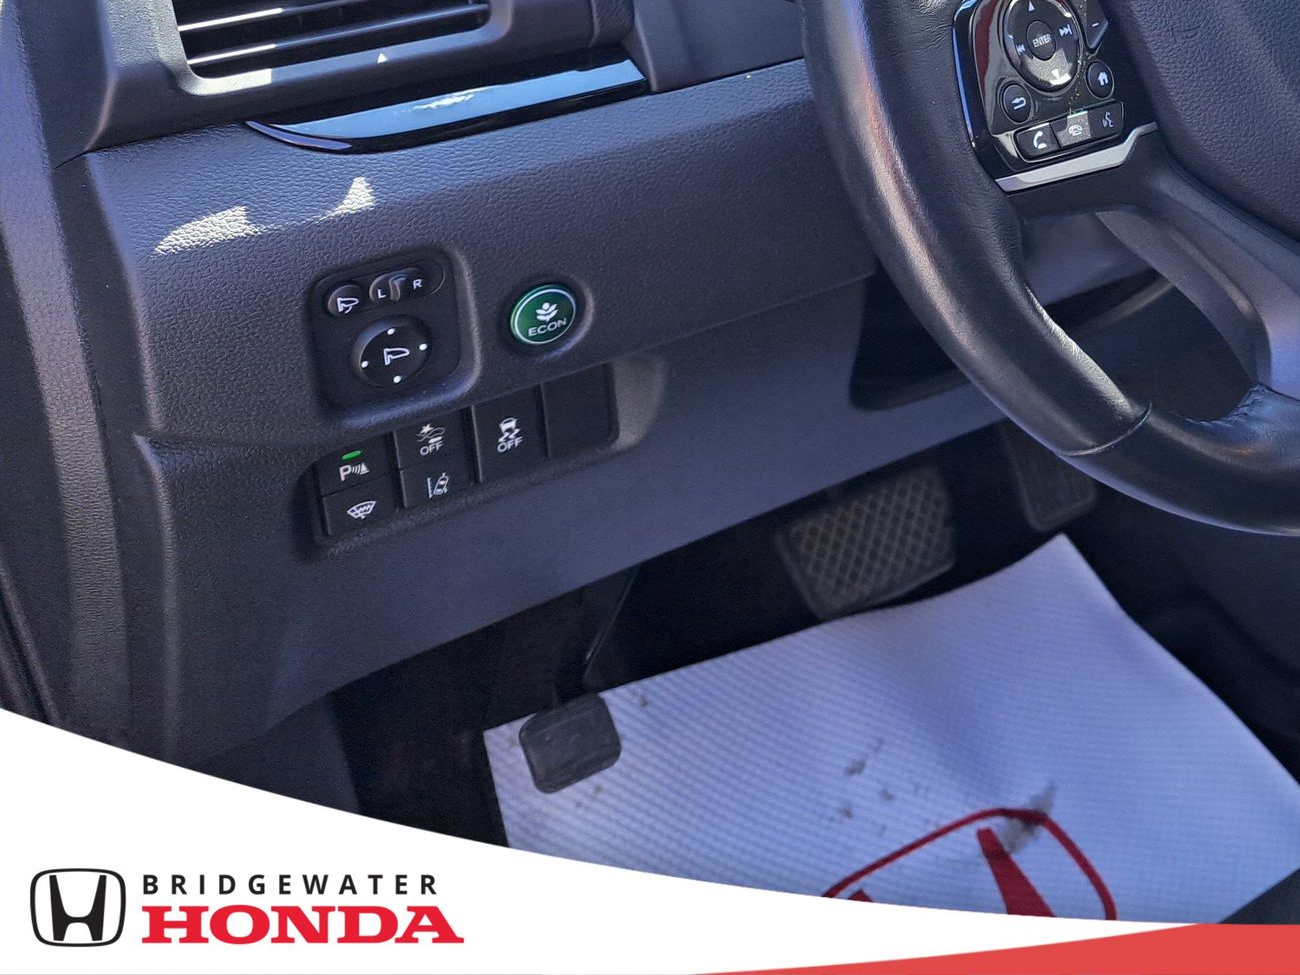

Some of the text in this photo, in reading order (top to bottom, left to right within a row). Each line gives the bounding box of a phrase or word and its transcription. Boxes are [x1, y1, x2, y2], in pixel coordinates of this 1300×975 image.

[1032, 33, 1052, 47] ENTER
[413, 279, 422, 289] R
[377, 289, 386, 299] L
[528, 318, 567, 337] ECON
[420, 441, 444, 456] OFF
[497, 436, 523, 453] OFF
